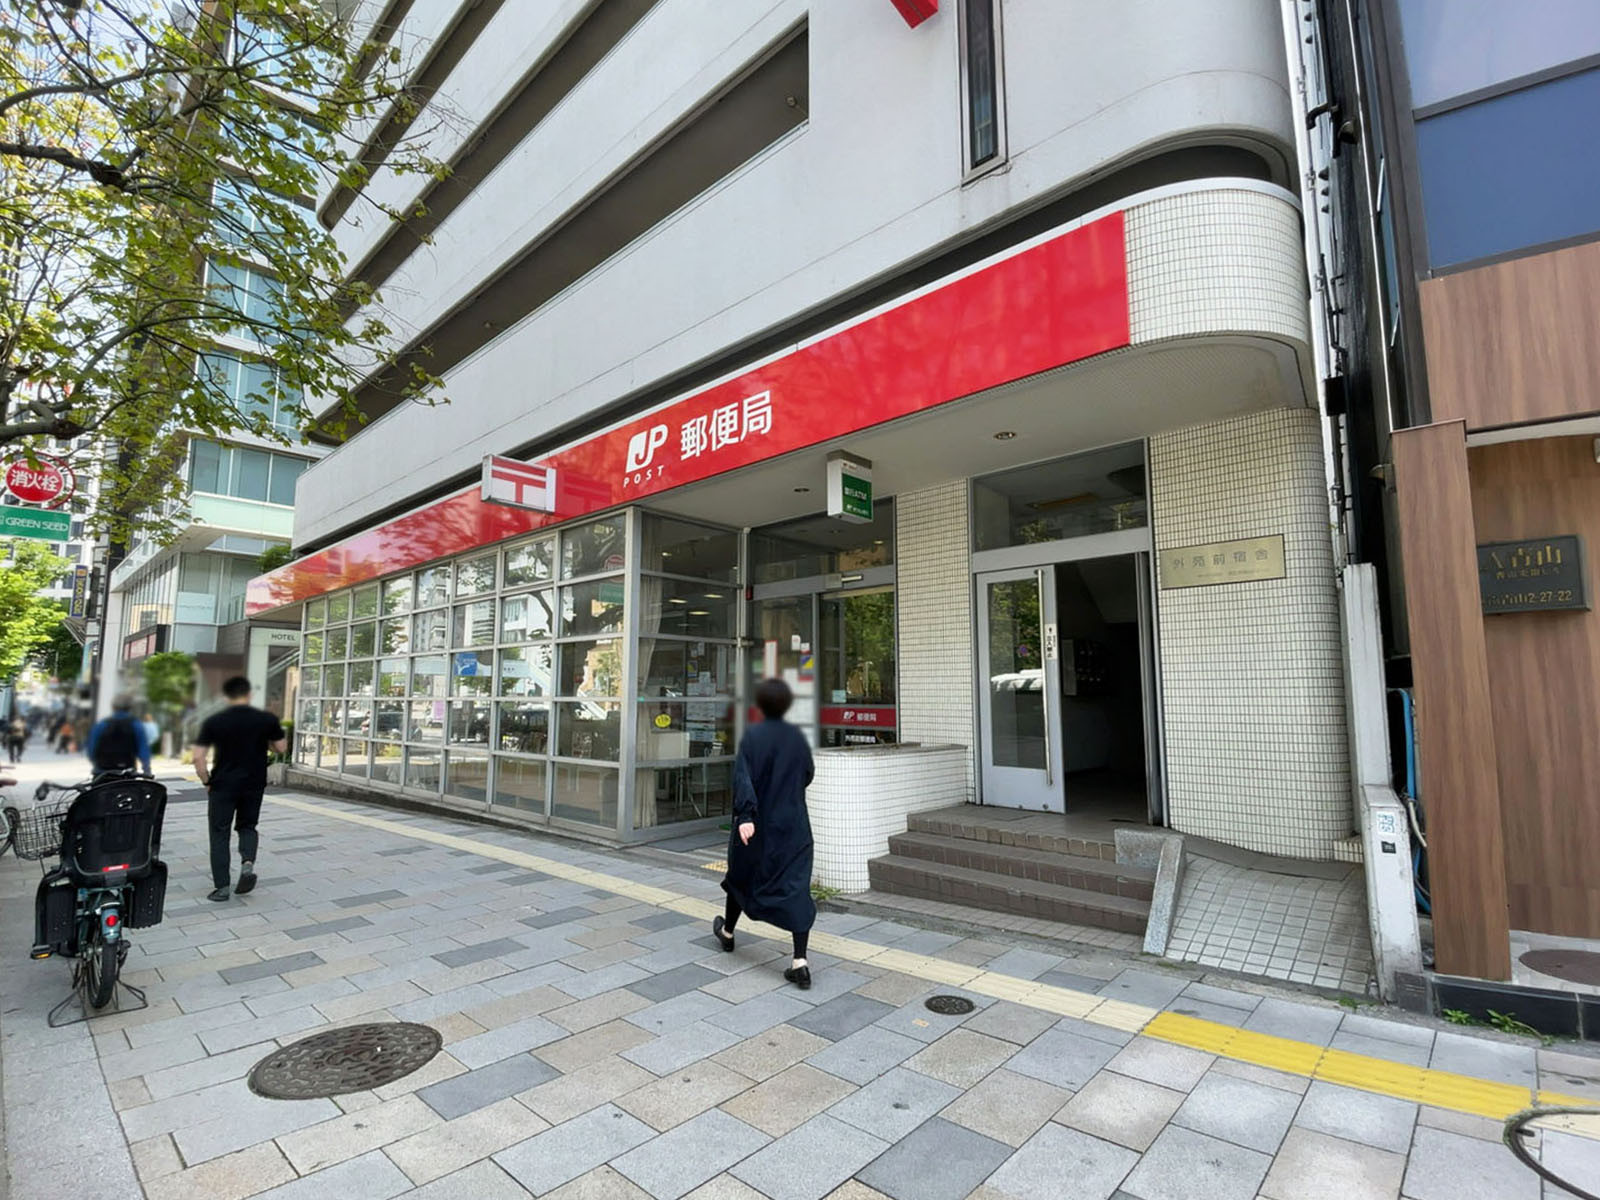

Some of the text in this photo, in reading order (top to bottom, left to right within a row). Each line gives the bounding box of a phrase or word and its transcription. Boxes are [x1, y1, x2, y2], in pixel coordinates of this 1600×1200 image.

[625, 390, 772, 473] JP 郵便局
[10, 469, 60, 492] 消火栓
[623, 465, 664, 488] POST
[6, 517, 69, 532] GREEN SEED
[1173, 550, 1268, 570] 外苑前宿舎
[271, 633, 296, 641] HOTEL
